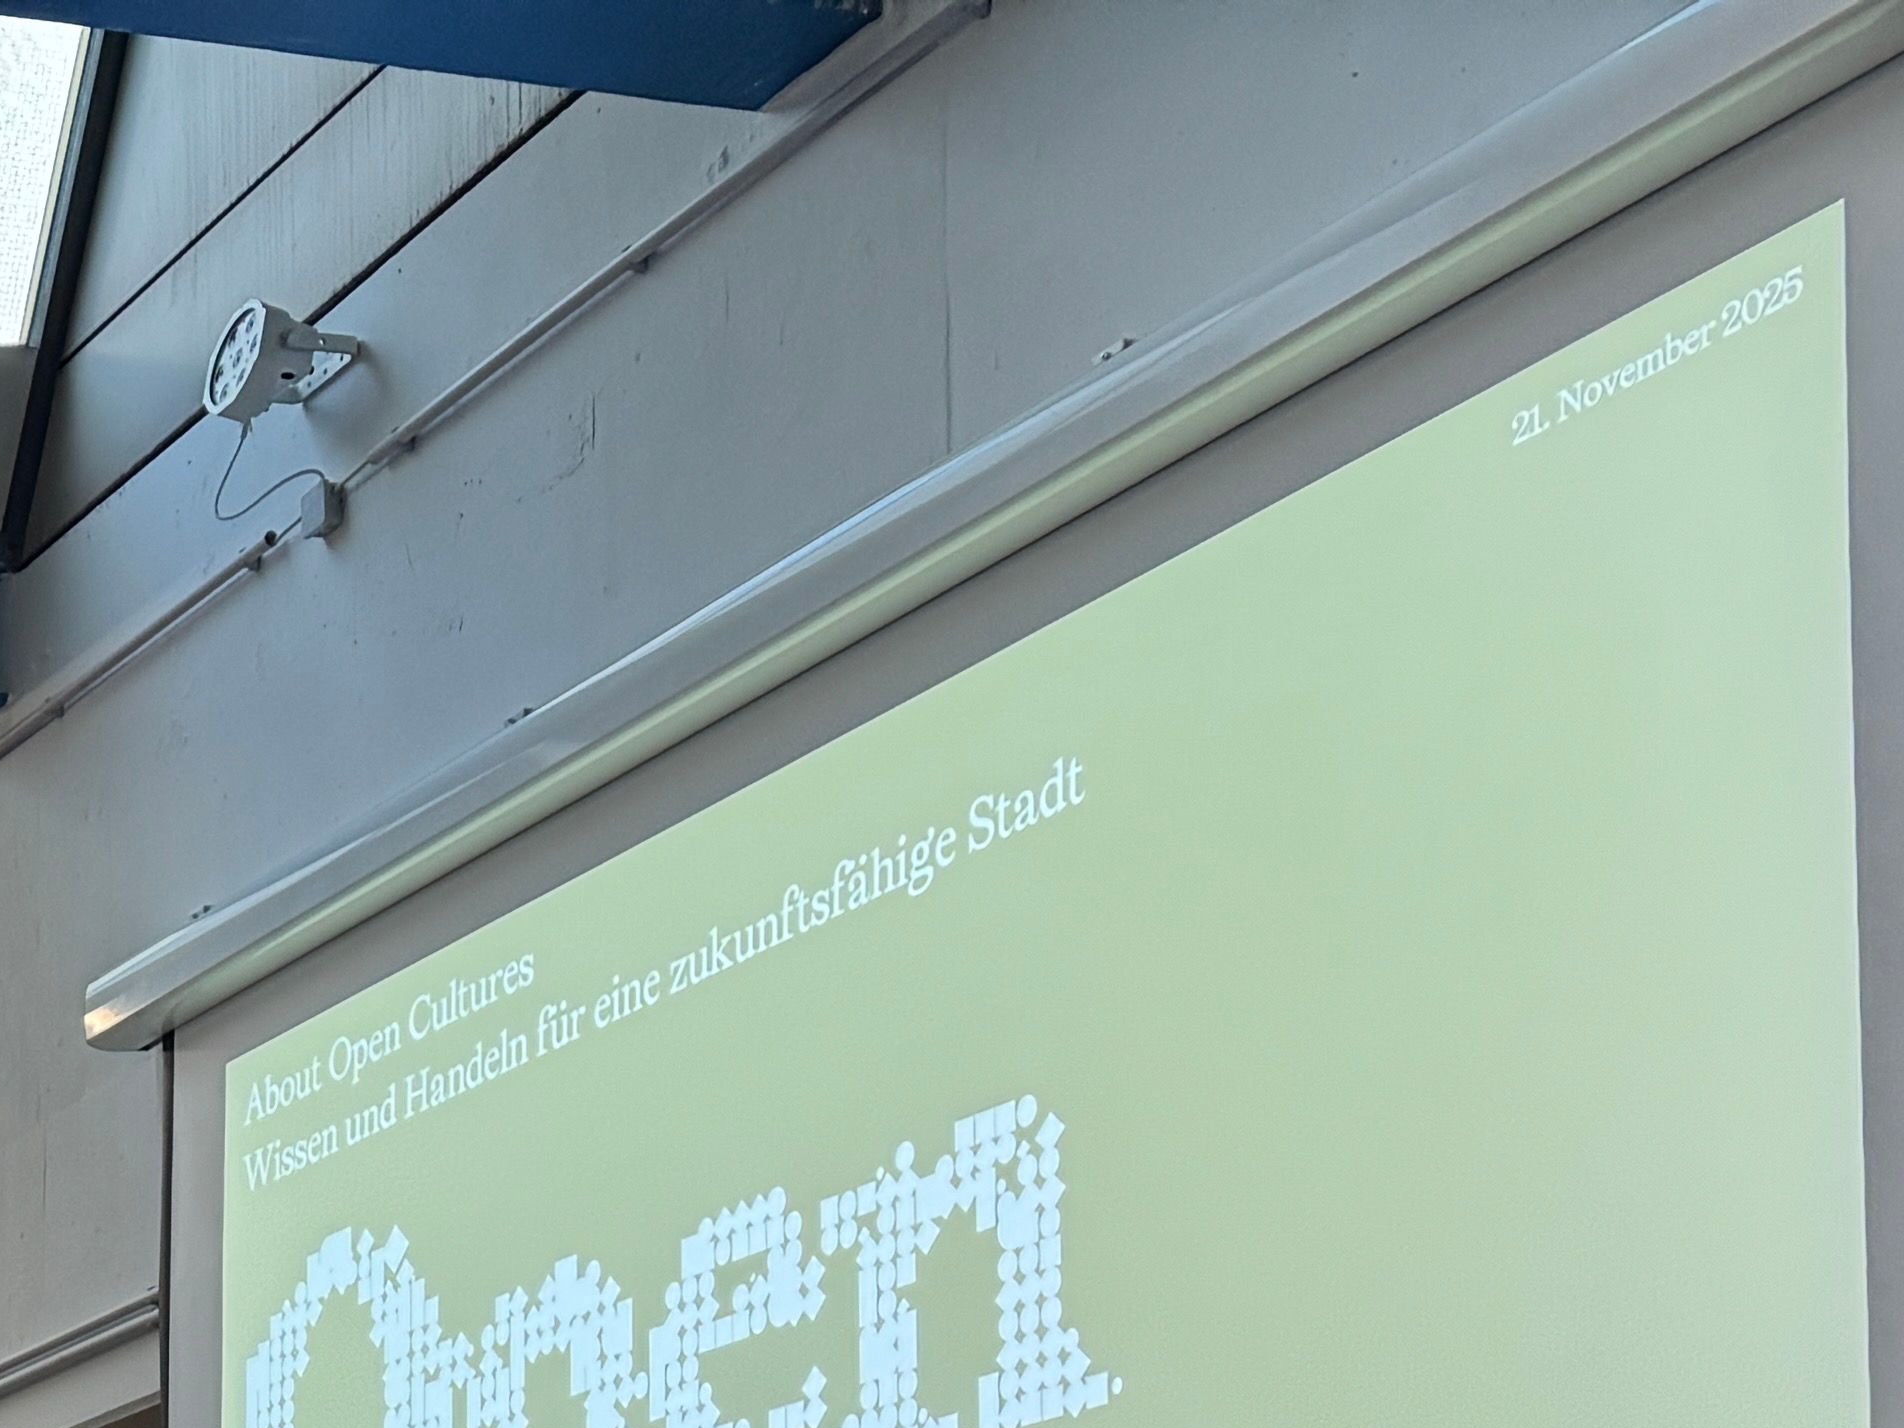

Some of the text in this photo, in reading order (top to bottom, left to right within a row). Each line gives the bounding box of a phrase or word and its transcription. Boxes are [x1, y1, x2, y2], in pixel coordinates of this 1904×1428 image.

[1511, 265, 1803, 446] 21. November 2025
[243, 755, 1086, 1192] Wissen und Handeln für eine zukunftsfähige Stadt
[244, 953, 534, 1126] About Open Cultures
